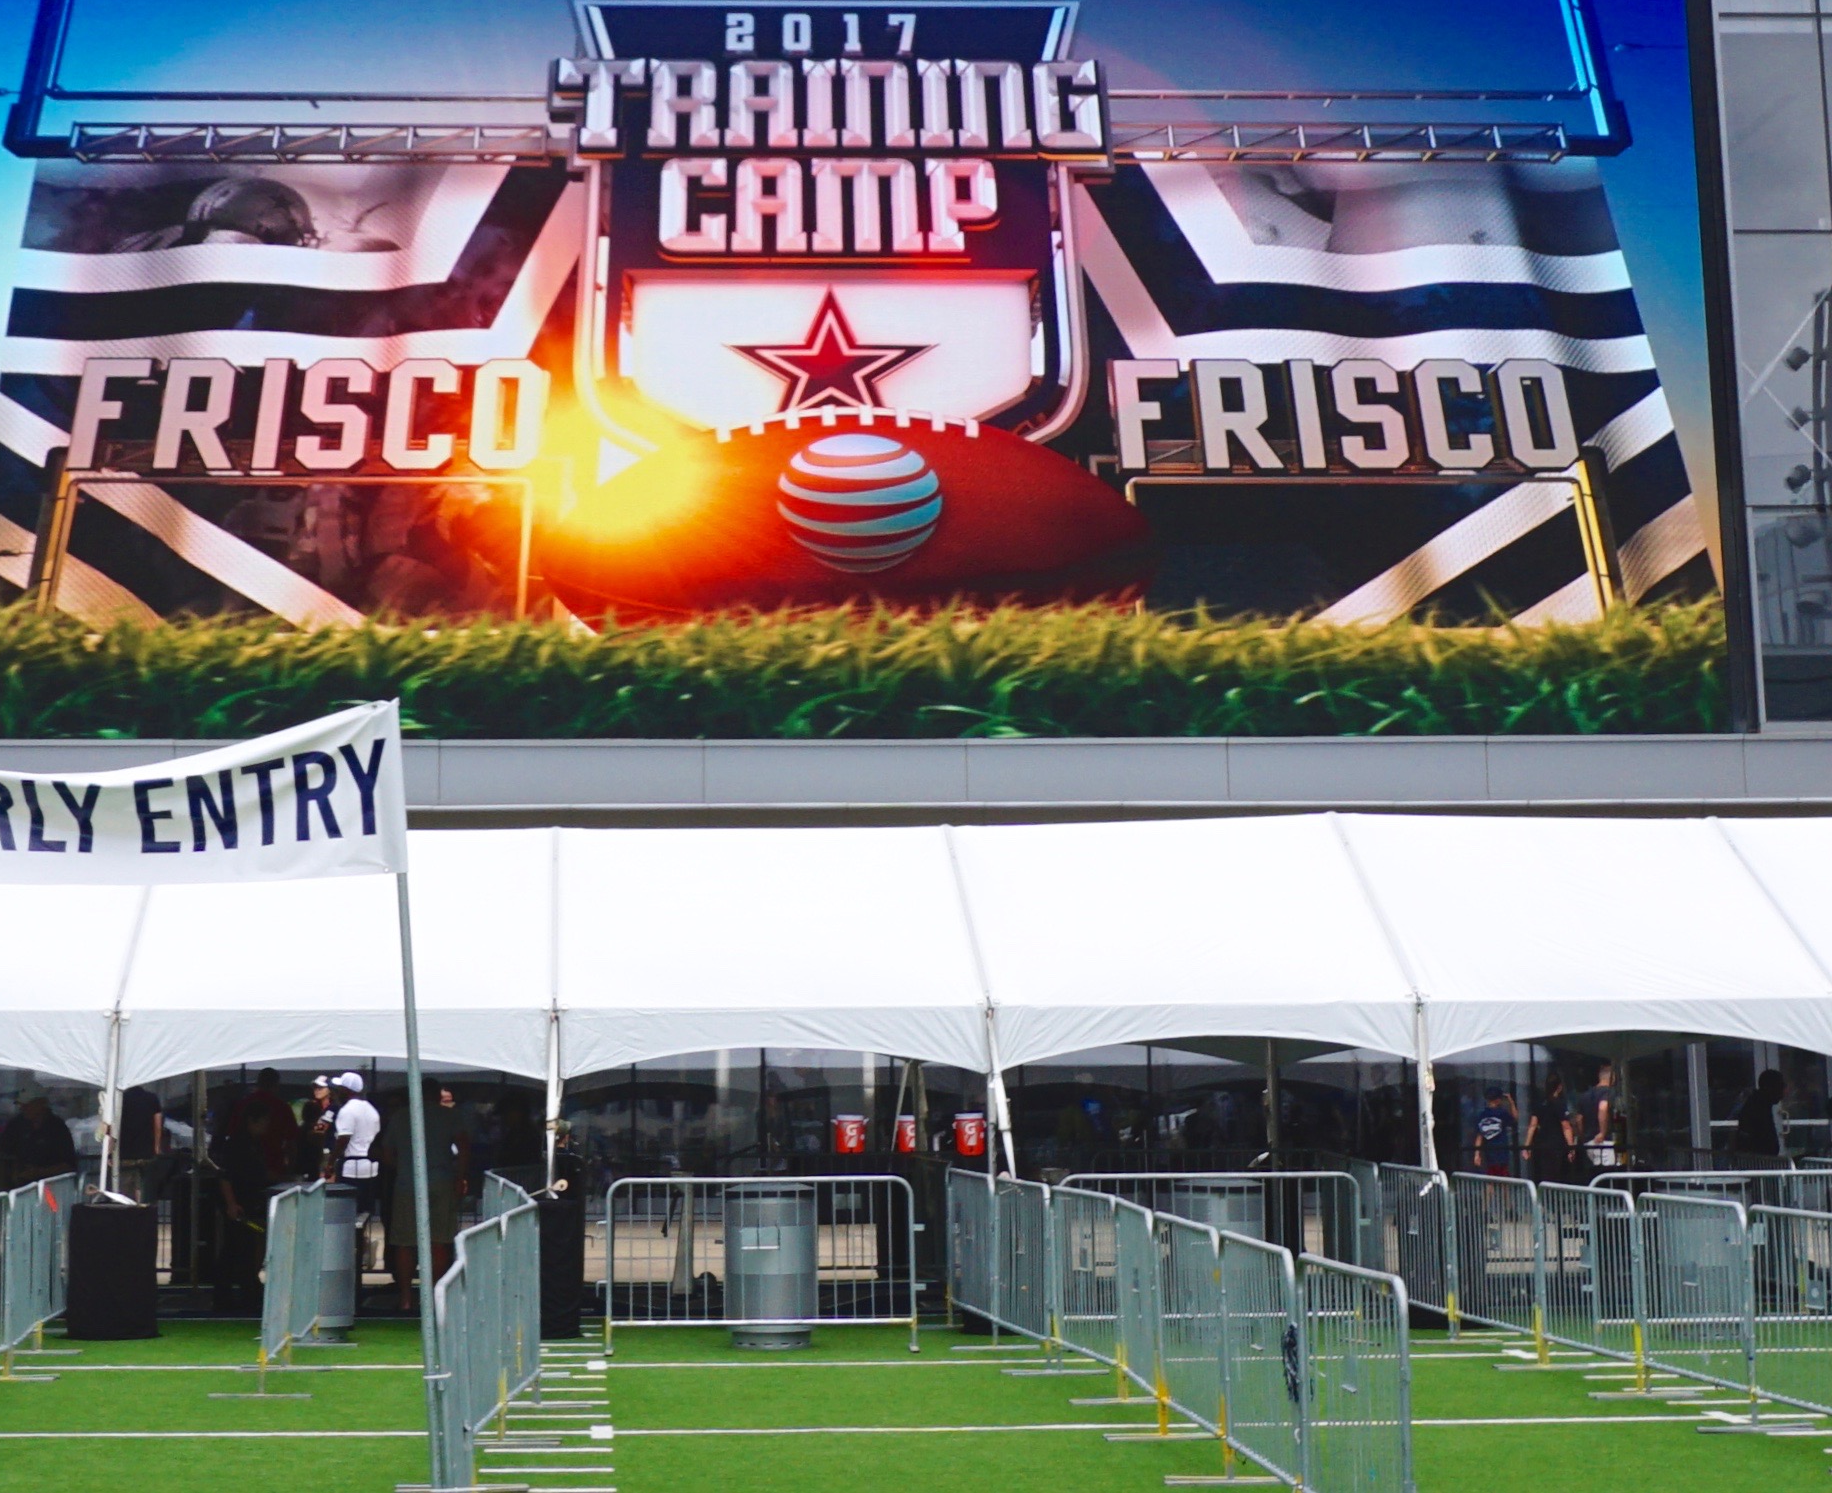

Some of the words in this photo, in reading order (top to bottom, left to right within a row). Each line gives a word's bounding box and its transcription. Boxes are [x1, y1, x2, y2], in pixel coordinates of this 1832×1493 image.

[724, 12, 917, 54] 2017
[555, 58, 1104, 150] TRAINING
[657, 157, 999, 254] CAMP
[67, 357, 545, 471] FRISCO
[1110, 358, 1581, 471] FRISCO
[132, 737, 387, 854] ENTRY
